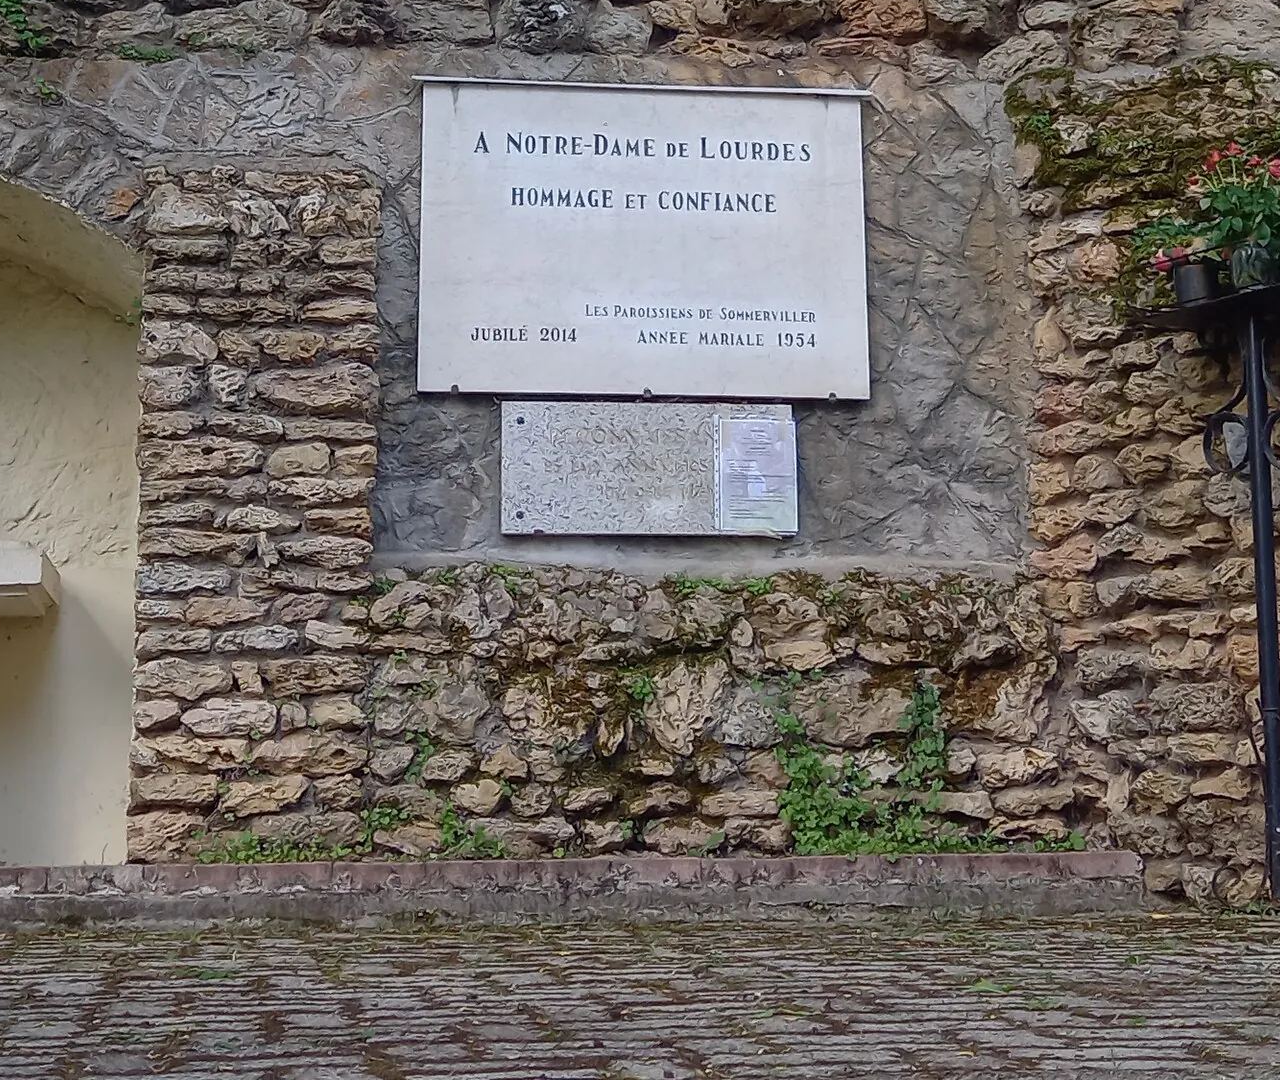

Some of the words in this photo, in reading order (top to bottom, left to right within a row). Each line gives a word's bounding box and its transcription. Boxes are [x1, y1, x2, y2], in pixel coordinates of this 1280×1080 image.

[472, 130, 491, 155] A
[505, 131, 656, 158] NOTRE-DAME
[666, 142, 690, 158] DE
[700, 136, 811, 162] LOURDES
[511, 186, 614, 209] HOMMAGE
[624, 192, 648, 210] ET
[657, 190, 777, 213] CONFIANCE
[585, 303, 609, 318] LES
[613, 304, 694, 320] PAROISSIENS
[698, 308, 714, 320] DE
[719, 307, 816, 324] SOMMERVILLER
[470, 324, 529, 343] JUBILÉ
[539, 326, 578, 343] 2014
[698, 331, 765, 347] MARIALE
[777, 332, 816, 348] 1954
